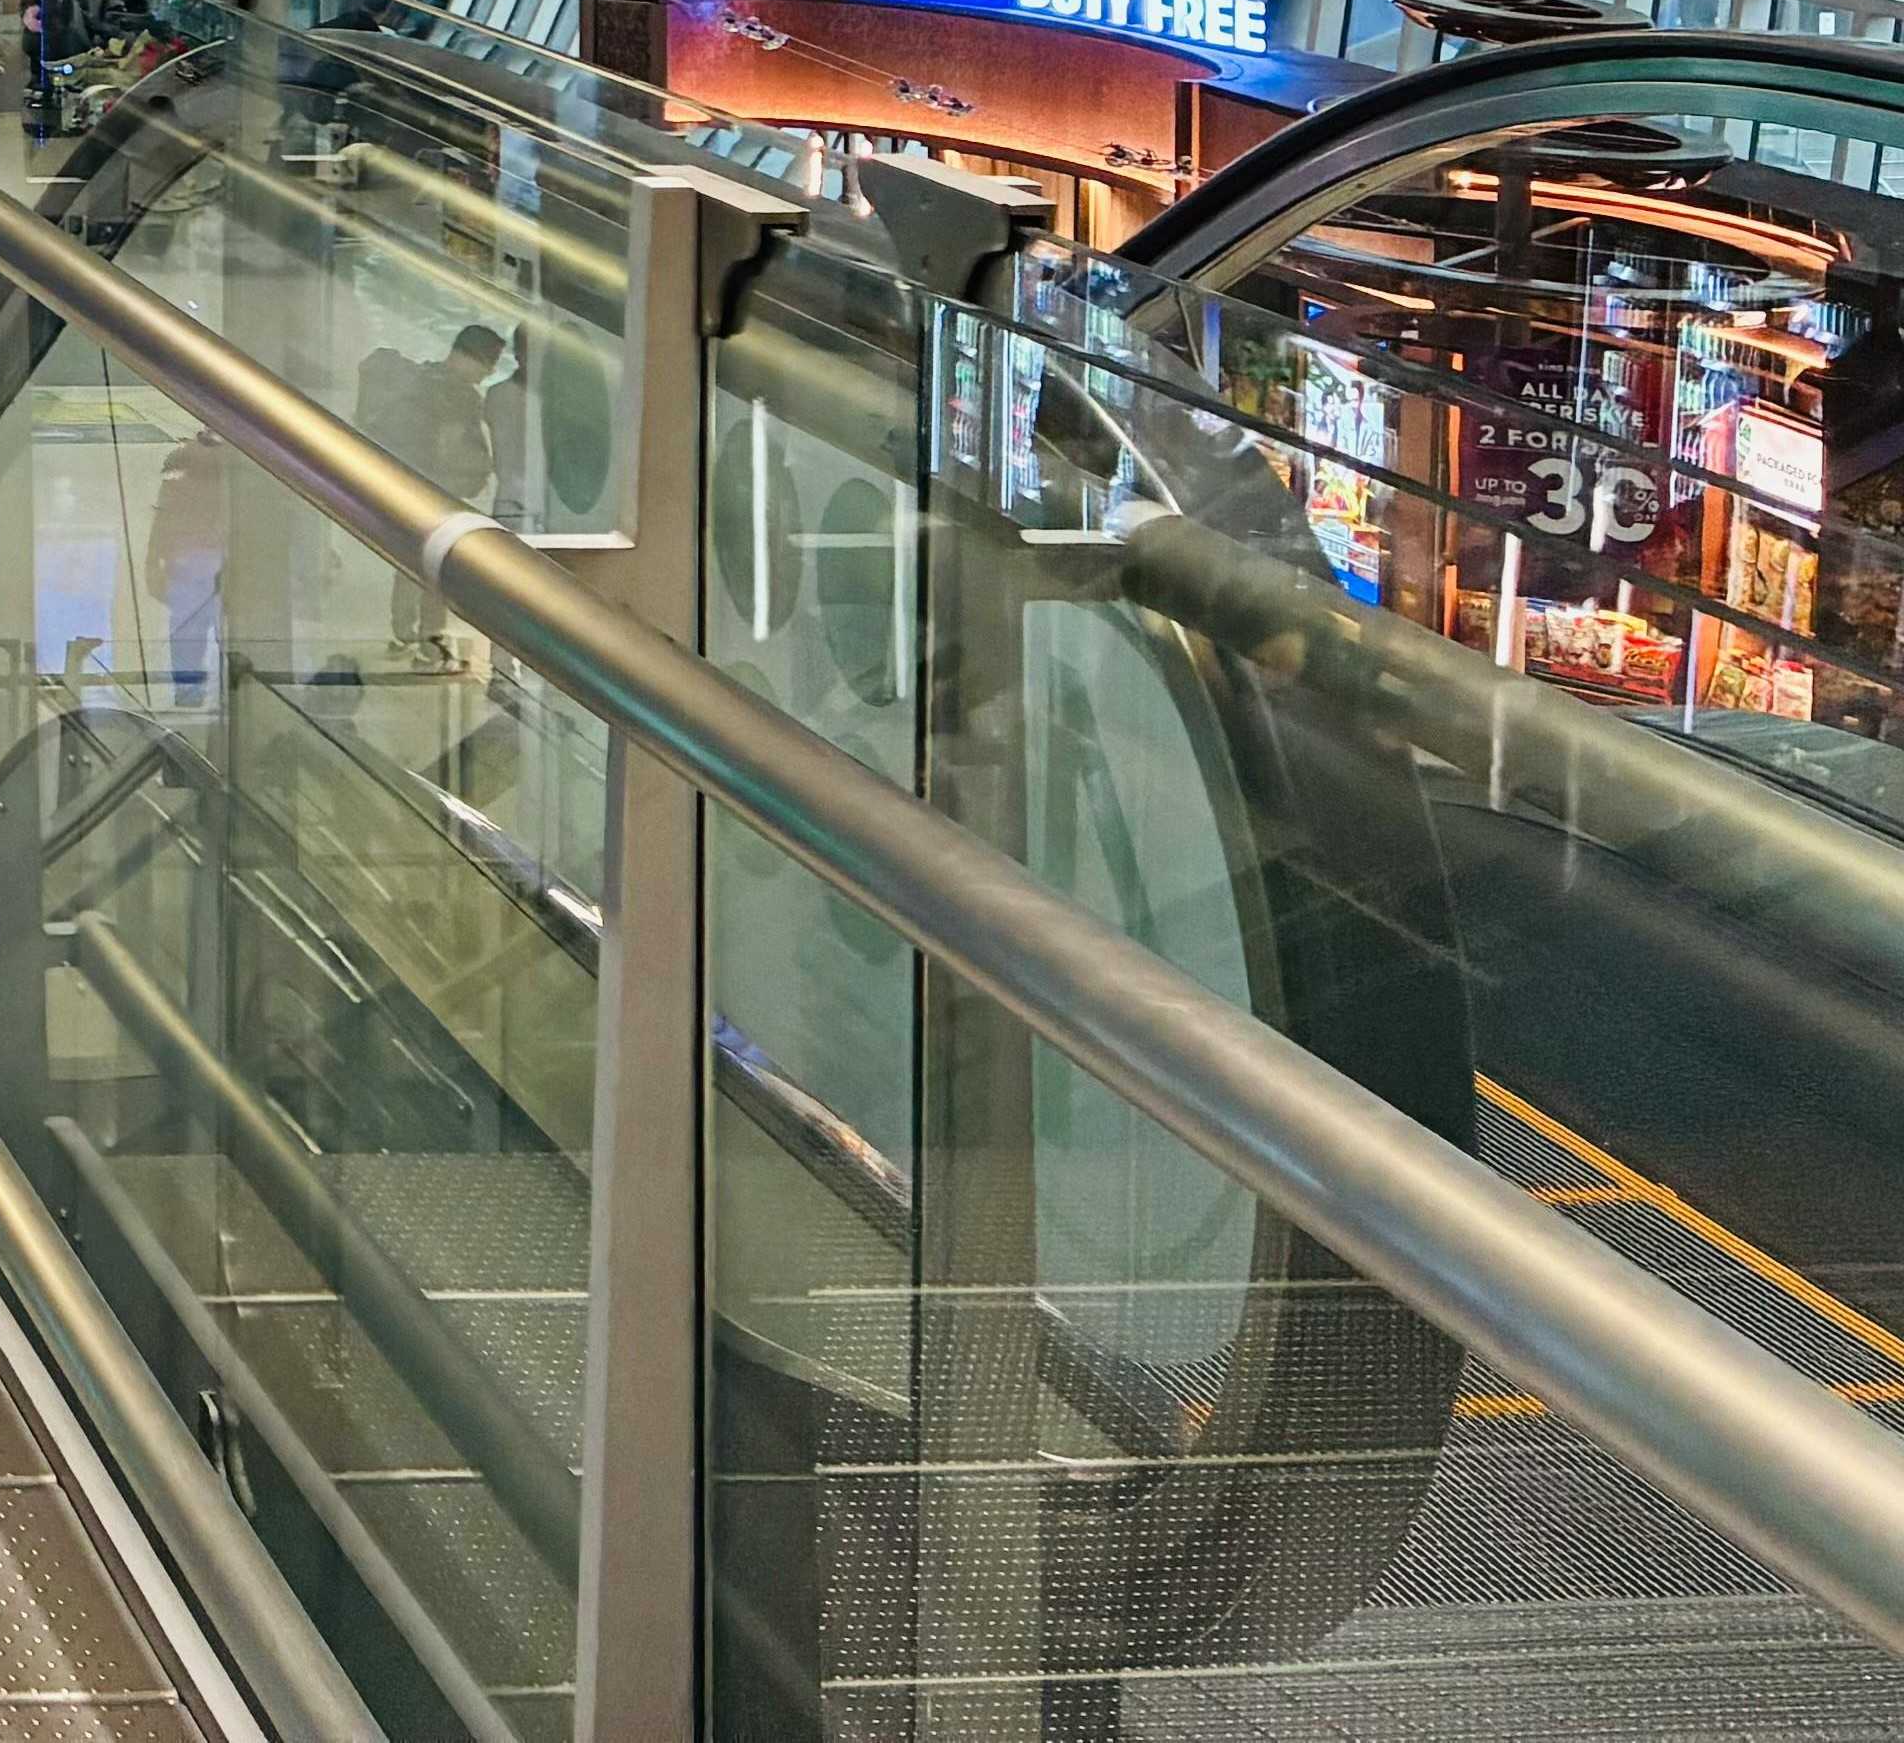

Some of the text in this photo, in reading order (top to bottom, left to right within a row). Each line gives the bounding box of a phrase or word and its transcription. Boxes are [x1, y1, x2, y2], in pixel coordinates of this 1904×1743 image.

[1521, 382, 1563, 399] ALL
[1479, 425, 1495, 444] 2
[1508, 429, 1567, 450] FOR
[1475, 478, 1527, 494] UP TO
